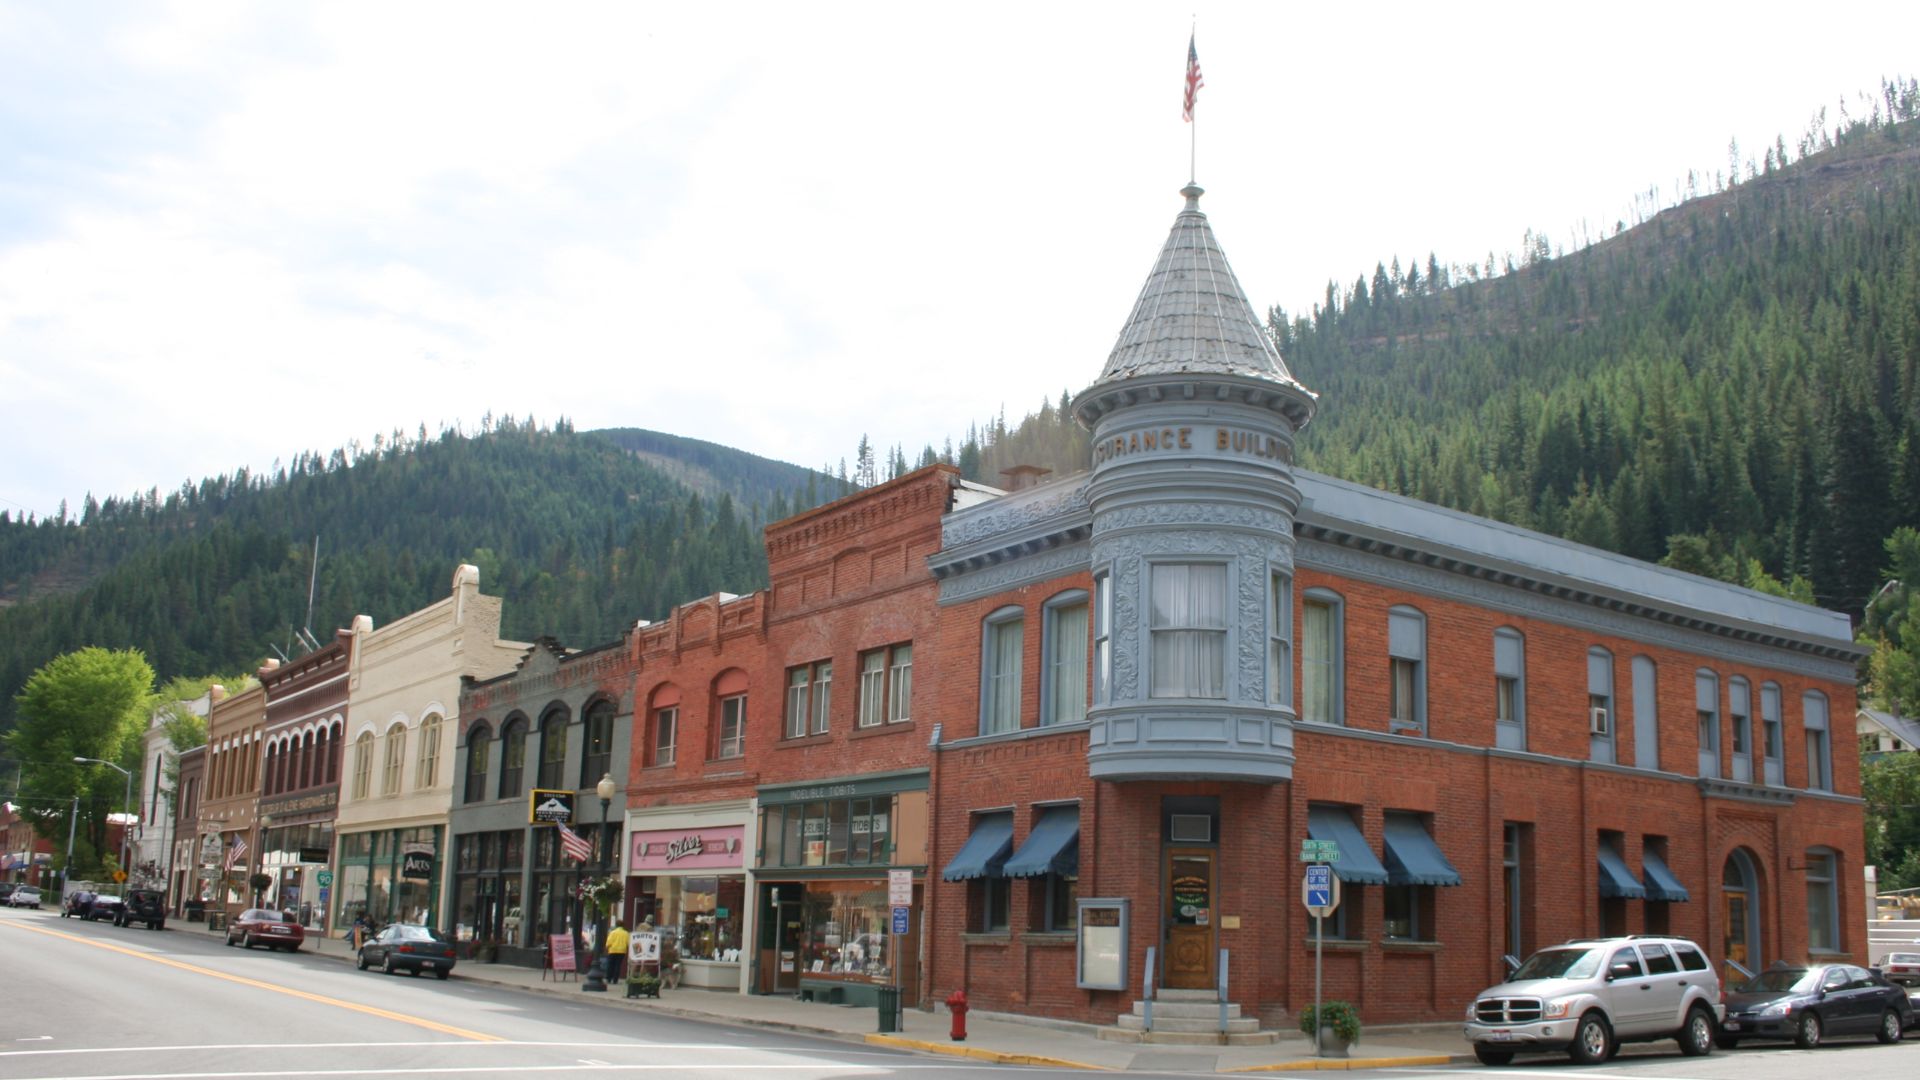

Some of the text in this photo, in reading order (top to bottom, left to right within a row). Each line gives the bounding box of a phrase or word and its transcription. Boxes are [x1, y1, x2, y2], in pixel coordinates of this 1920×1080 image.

[790, 784, 856, 800] INDELIBLE TIDBITS
[665, 835, 702, 863] Silver
[1318, 852, 1338, 860] STREET
[405, 856, 430, 872] ARTS
[1309, 868, 1328, 876] CENTER
[320, 876, 331, 884] 90
